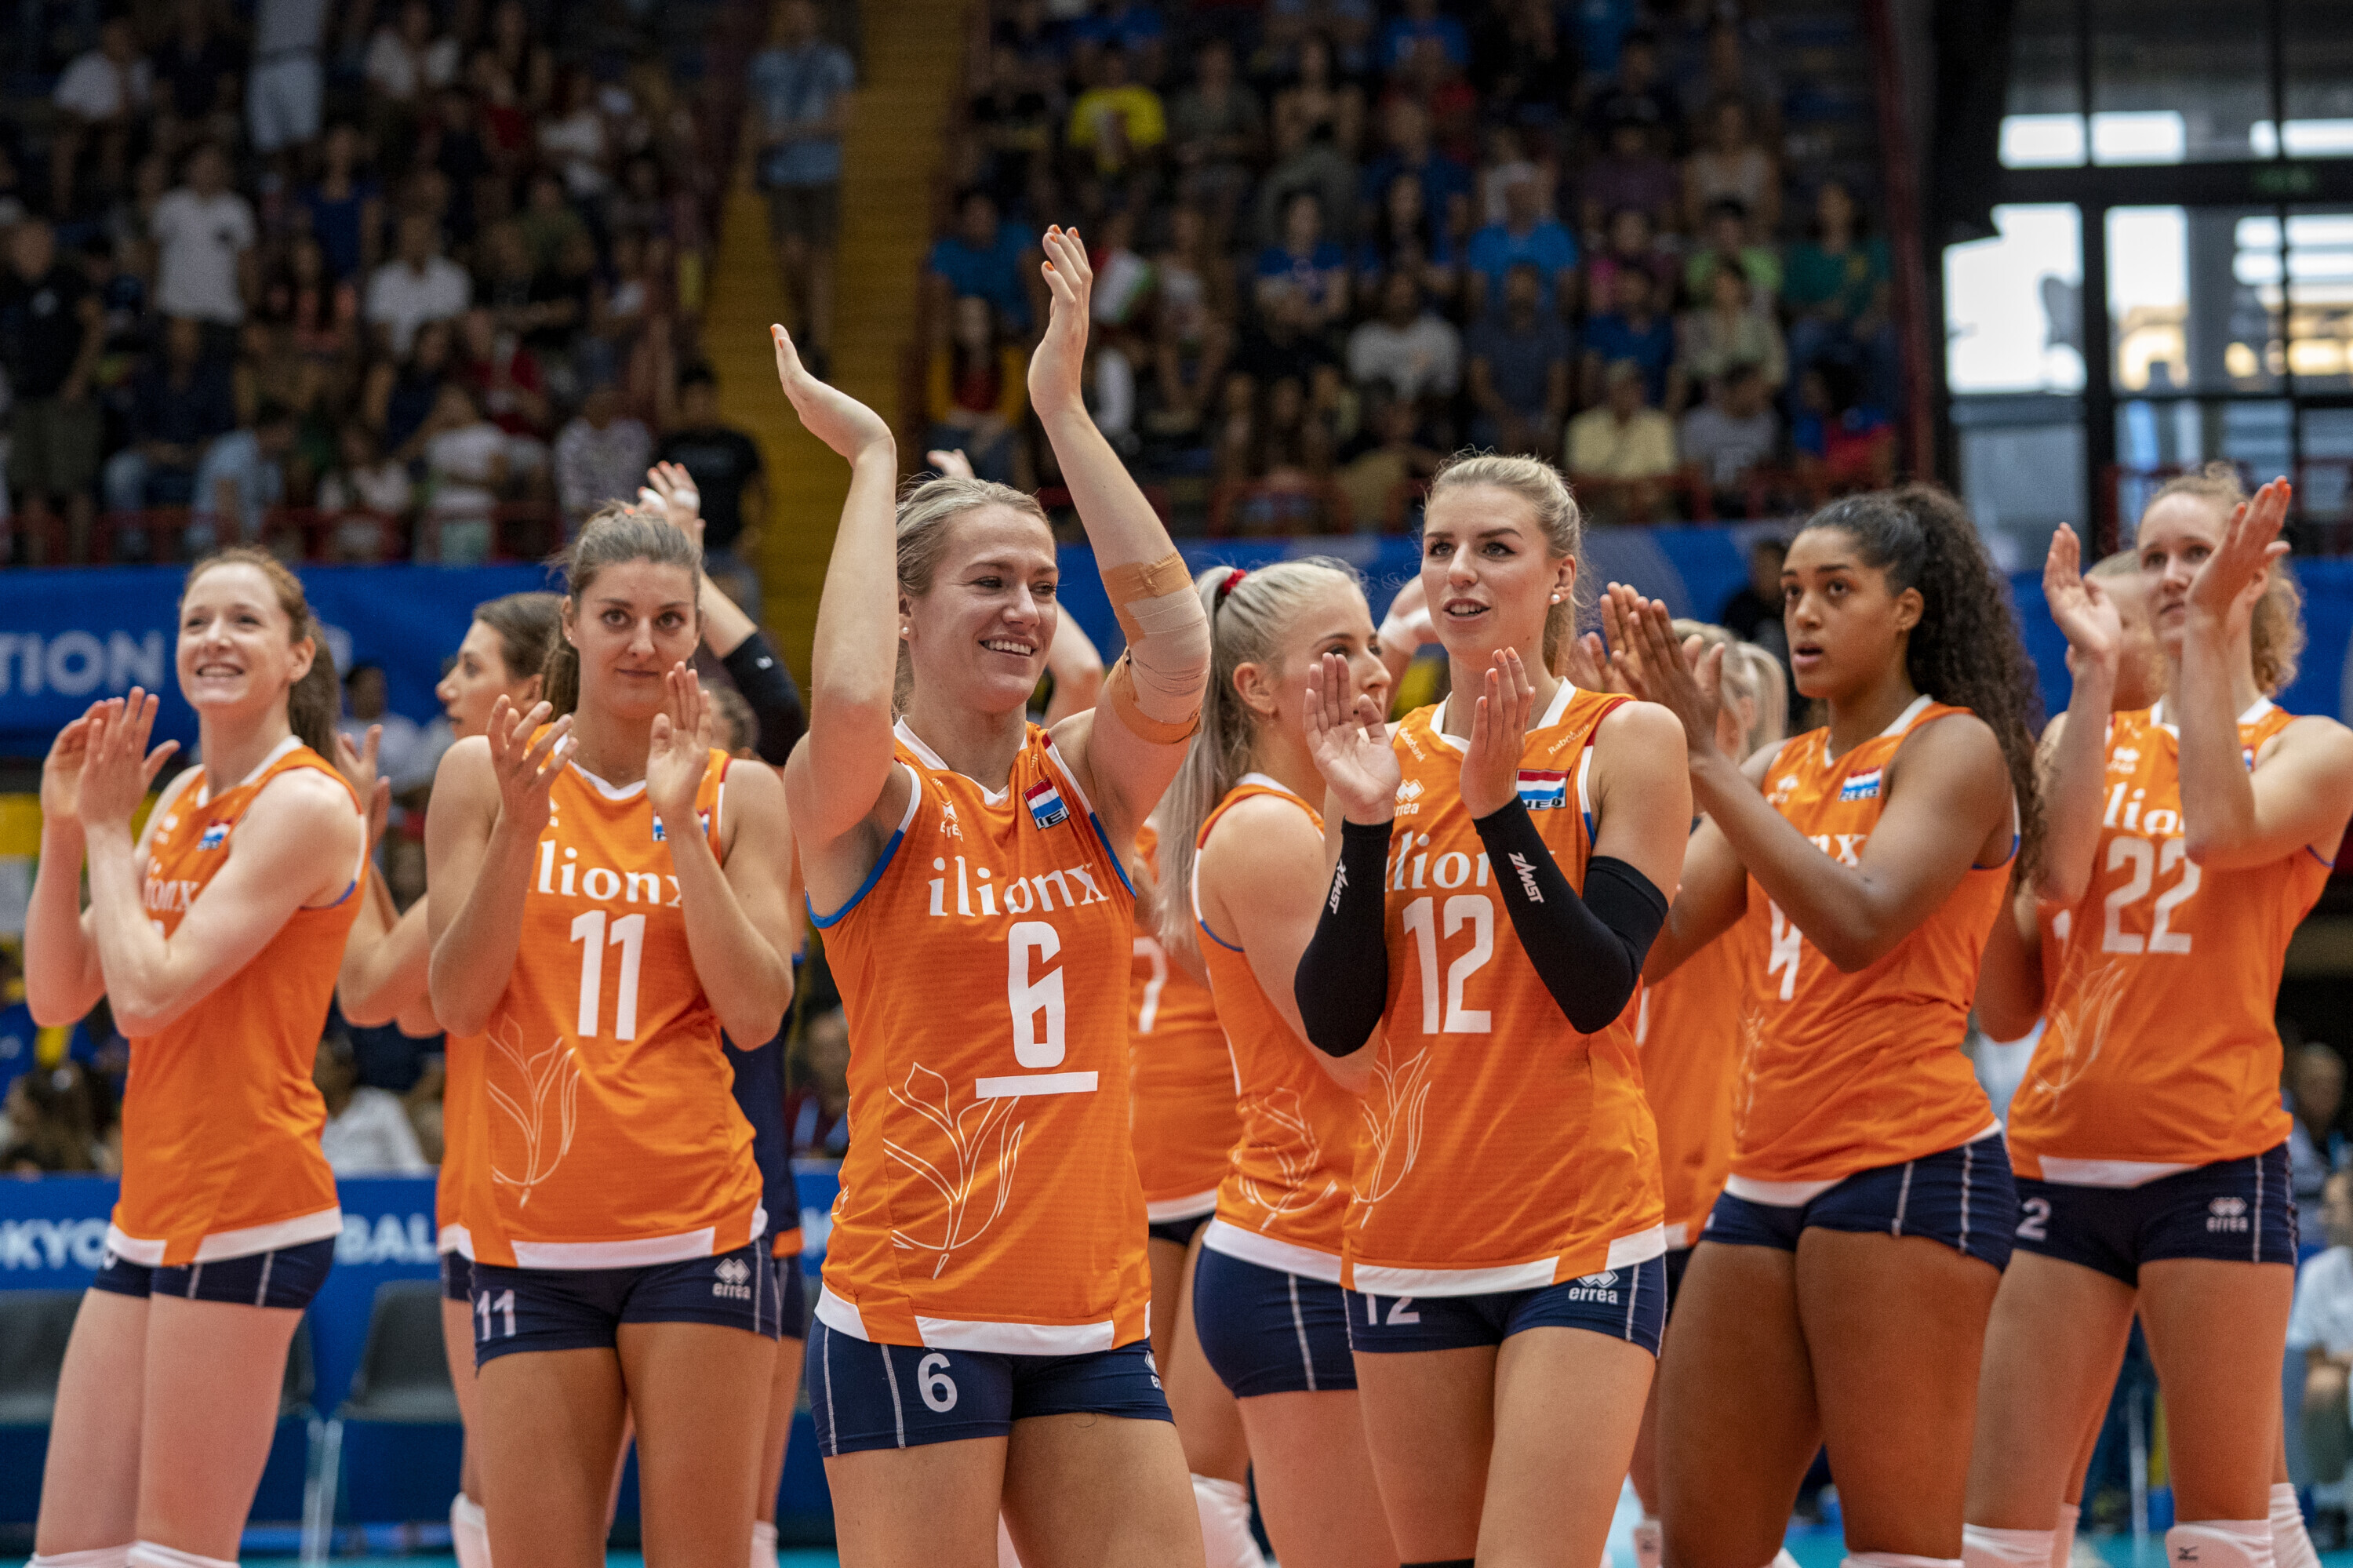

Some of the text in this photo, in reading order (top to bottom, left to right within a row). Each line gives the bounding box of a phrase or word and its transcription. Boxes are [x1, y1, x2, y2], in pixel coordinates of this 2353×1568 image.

[1394, 802, 1420, 817] rrea
[2103, 781, 2185, 834] lio
[528, 839, 682, 908] lion
[928, 855, 1110, 918] ilionx
[1507, 852, 1545, 904] ZAMST
[2102, 835, 2202, 955] 22
[570, 909, 646, 1042] 11
[1402, 893, 1494, 1035] 12
[1008, 921, 1067, 1068] 6
[476, 1289, 516, 1342] 11
[712, 1282, 751, 1301] errea
[1568, 1286, 1619, 1305] errea
[918, 1352, 958, 1412] 6
